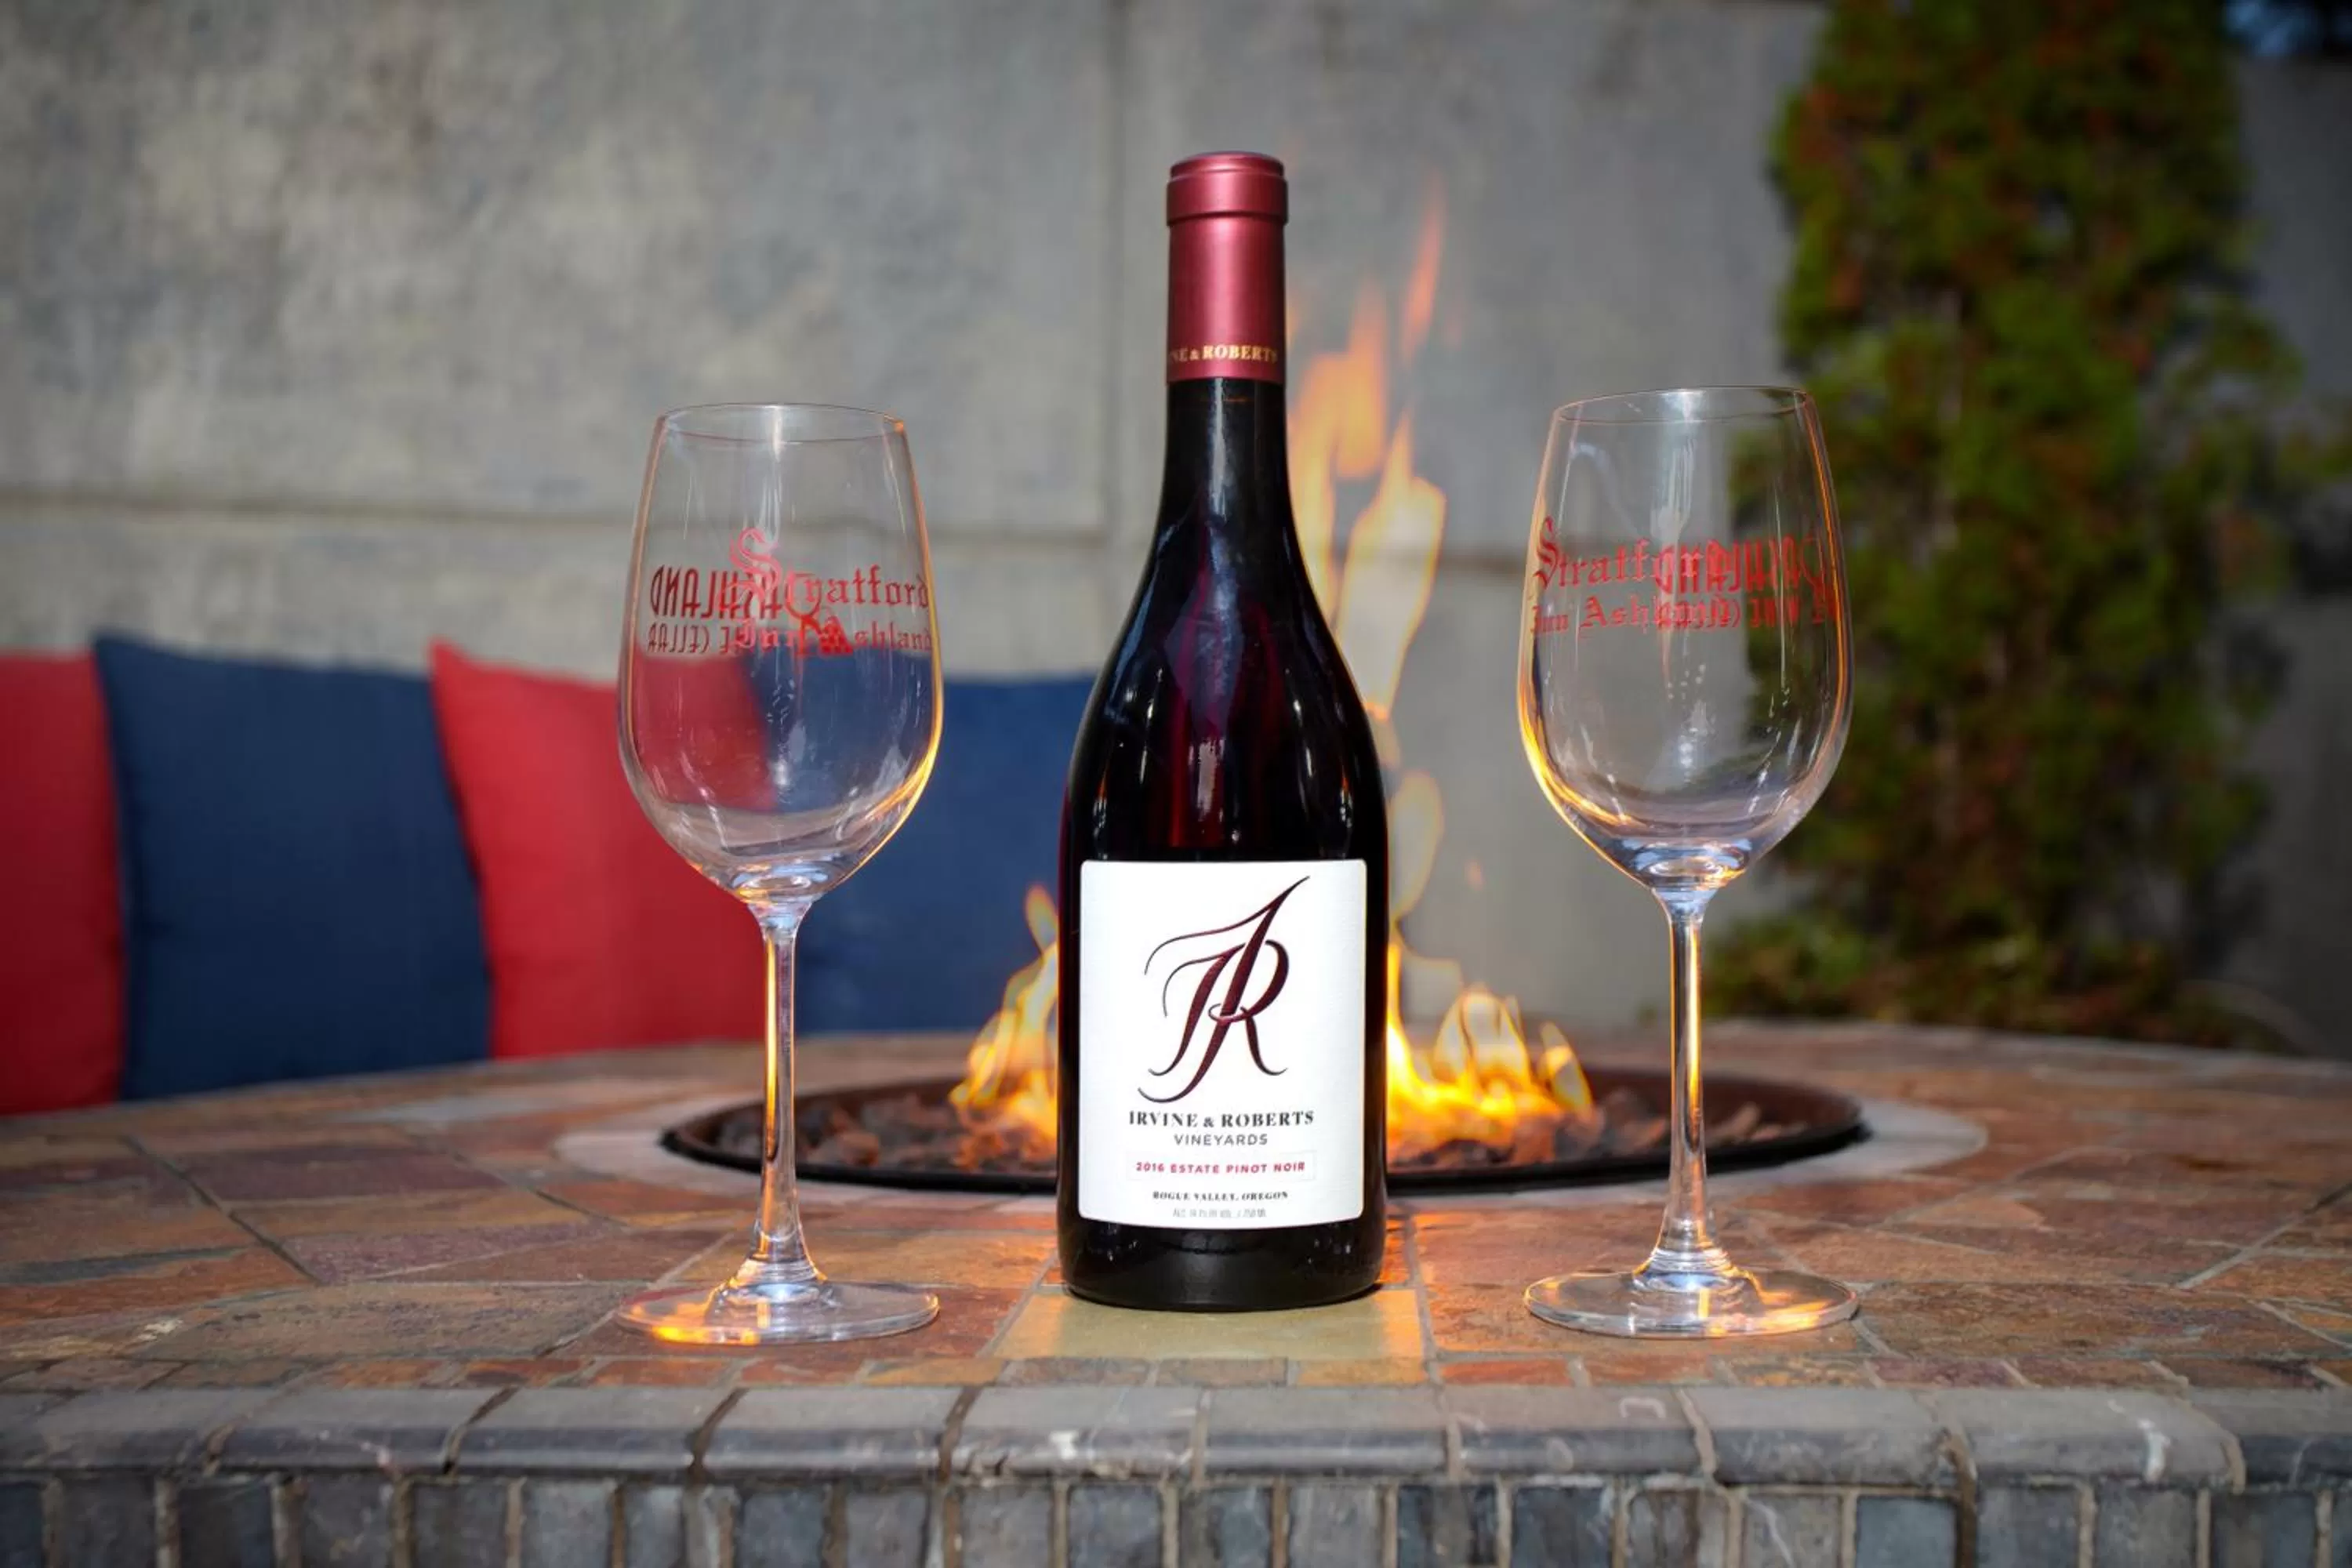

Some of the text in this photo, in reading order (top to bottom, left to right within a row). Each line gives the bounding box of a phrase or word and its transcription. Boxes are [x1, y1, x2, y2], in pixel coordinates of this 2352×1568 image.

[1203, 343, 1278, 364] ROBERTS
[1129, 1110, 1314, 1127] IRVINE & ROBERTS
[1174, 1134, 1268, 1146] VINEYARDS
[1136, 1162, 1305, 1174] 2016 ESTATE PINOT NOIR
[1152, 1191, 1190, 1201] ROGUE
[1241, 1191, 1288, 1201] OREGON
